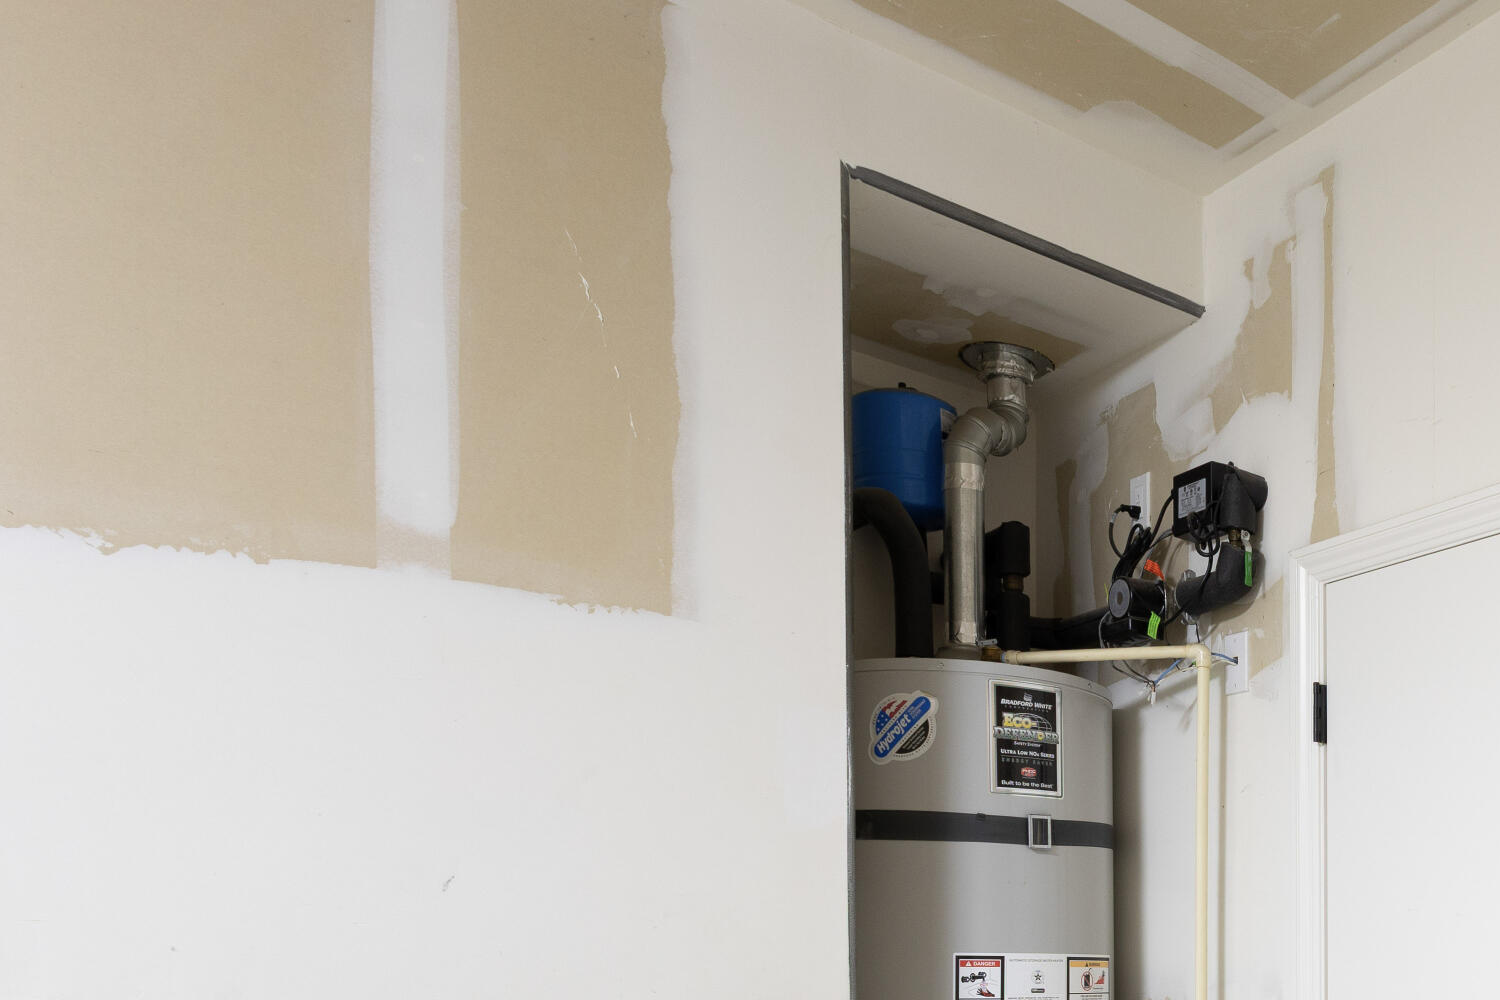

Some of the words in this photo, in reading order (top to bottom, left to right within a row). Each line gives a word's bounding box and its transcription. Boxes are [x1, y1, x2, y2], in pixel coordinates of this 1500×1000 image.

[1000, 698, 1033, 708] BRADFORD
[1034, 702, 1053, 710] WHITE
[877, 713, 911, 754] Hydrojet
[993, 726, 1060, 744] DEFENDER
